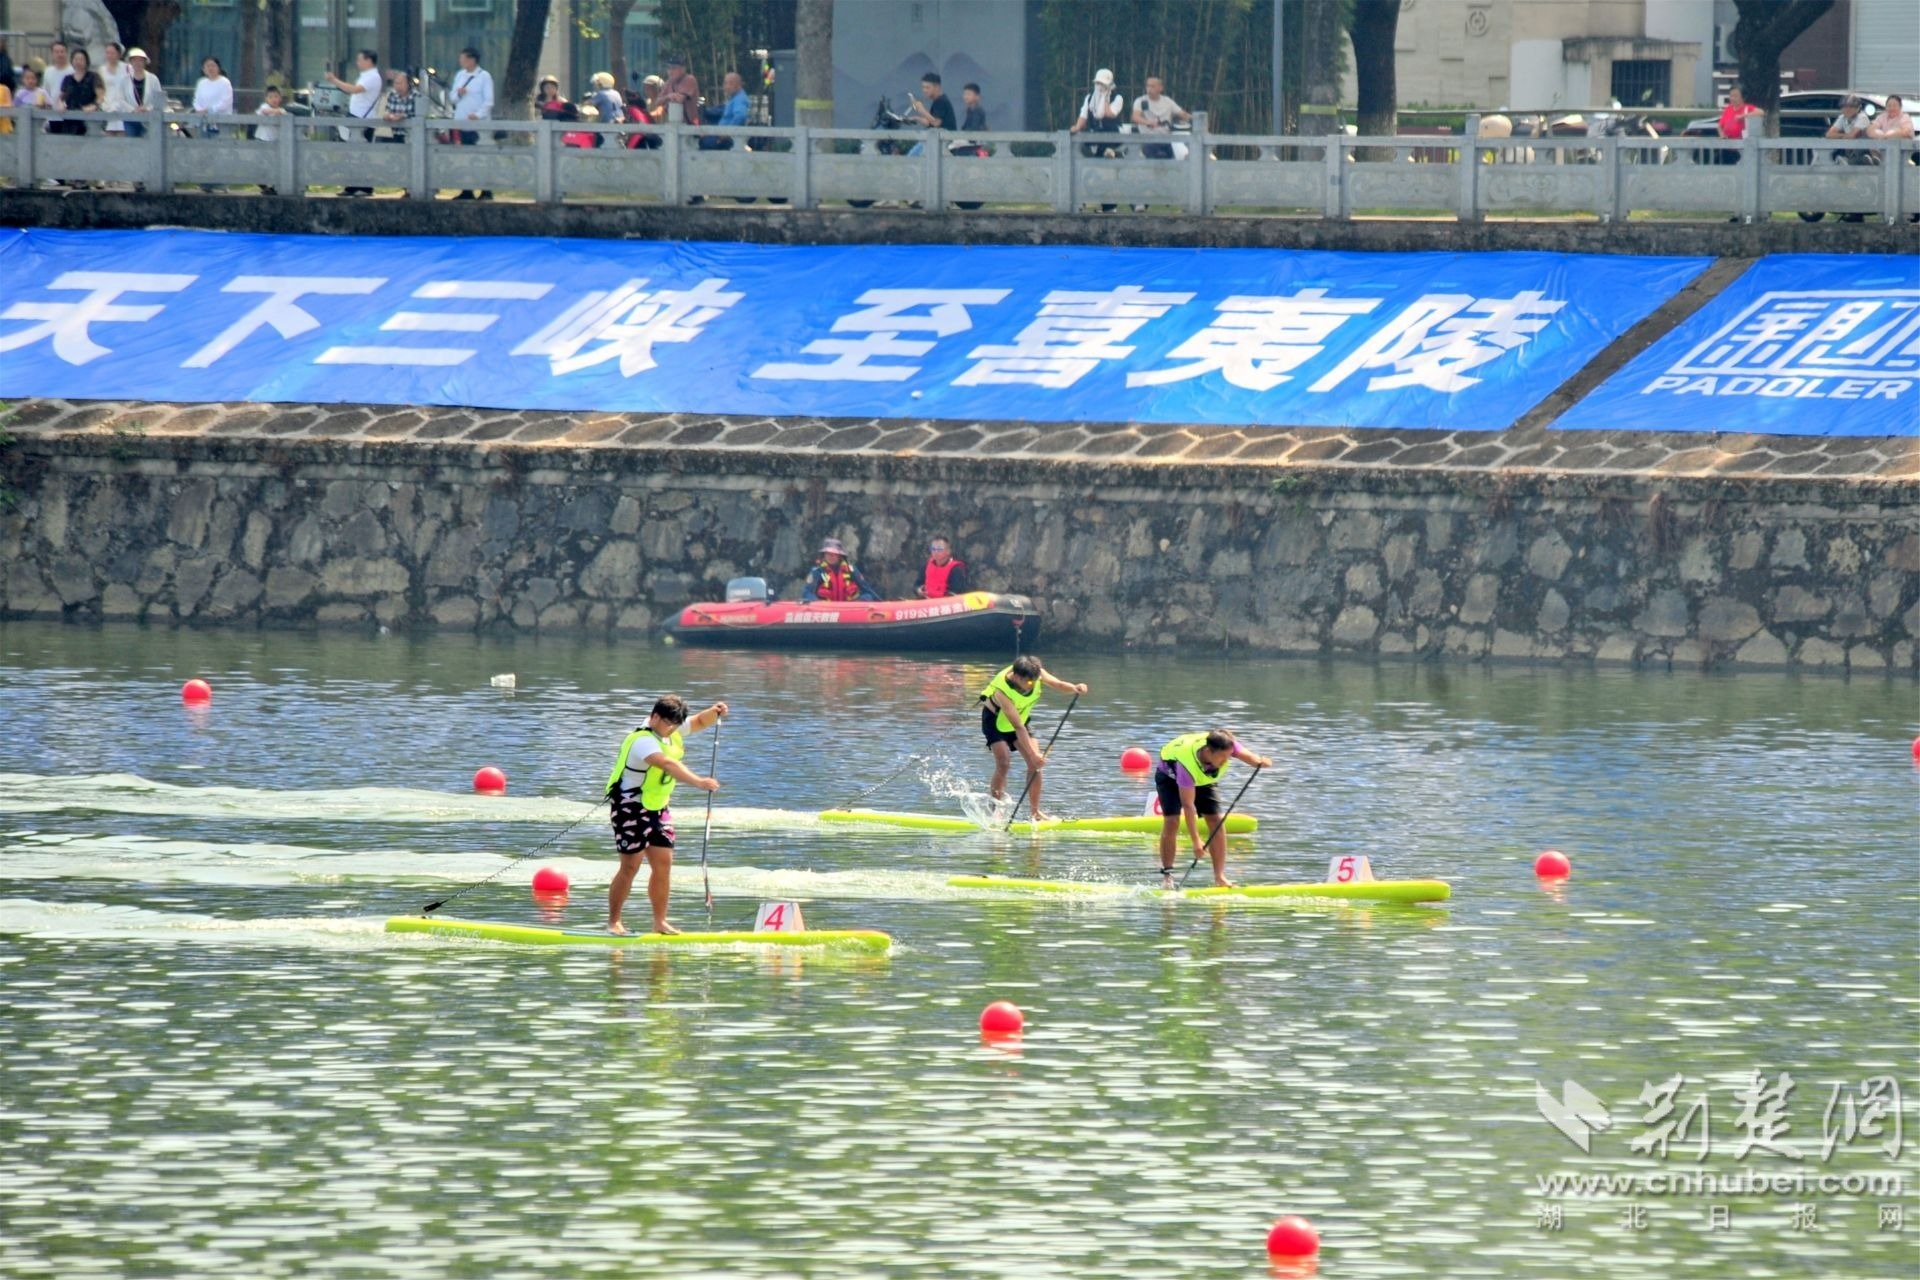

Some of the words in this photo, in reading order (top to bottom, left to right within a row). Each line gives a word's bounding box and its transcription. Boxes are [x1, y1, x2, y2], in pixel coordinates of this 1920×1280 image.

[0, 272, 746, 378] 天下三峡
[751, 285, 1568, 393] 至喜夷陵
[1640, 375, 1914, 400] PADDLER
[1337, 857, 1356, 882] 5
[764, 904, 785, 931] 4
